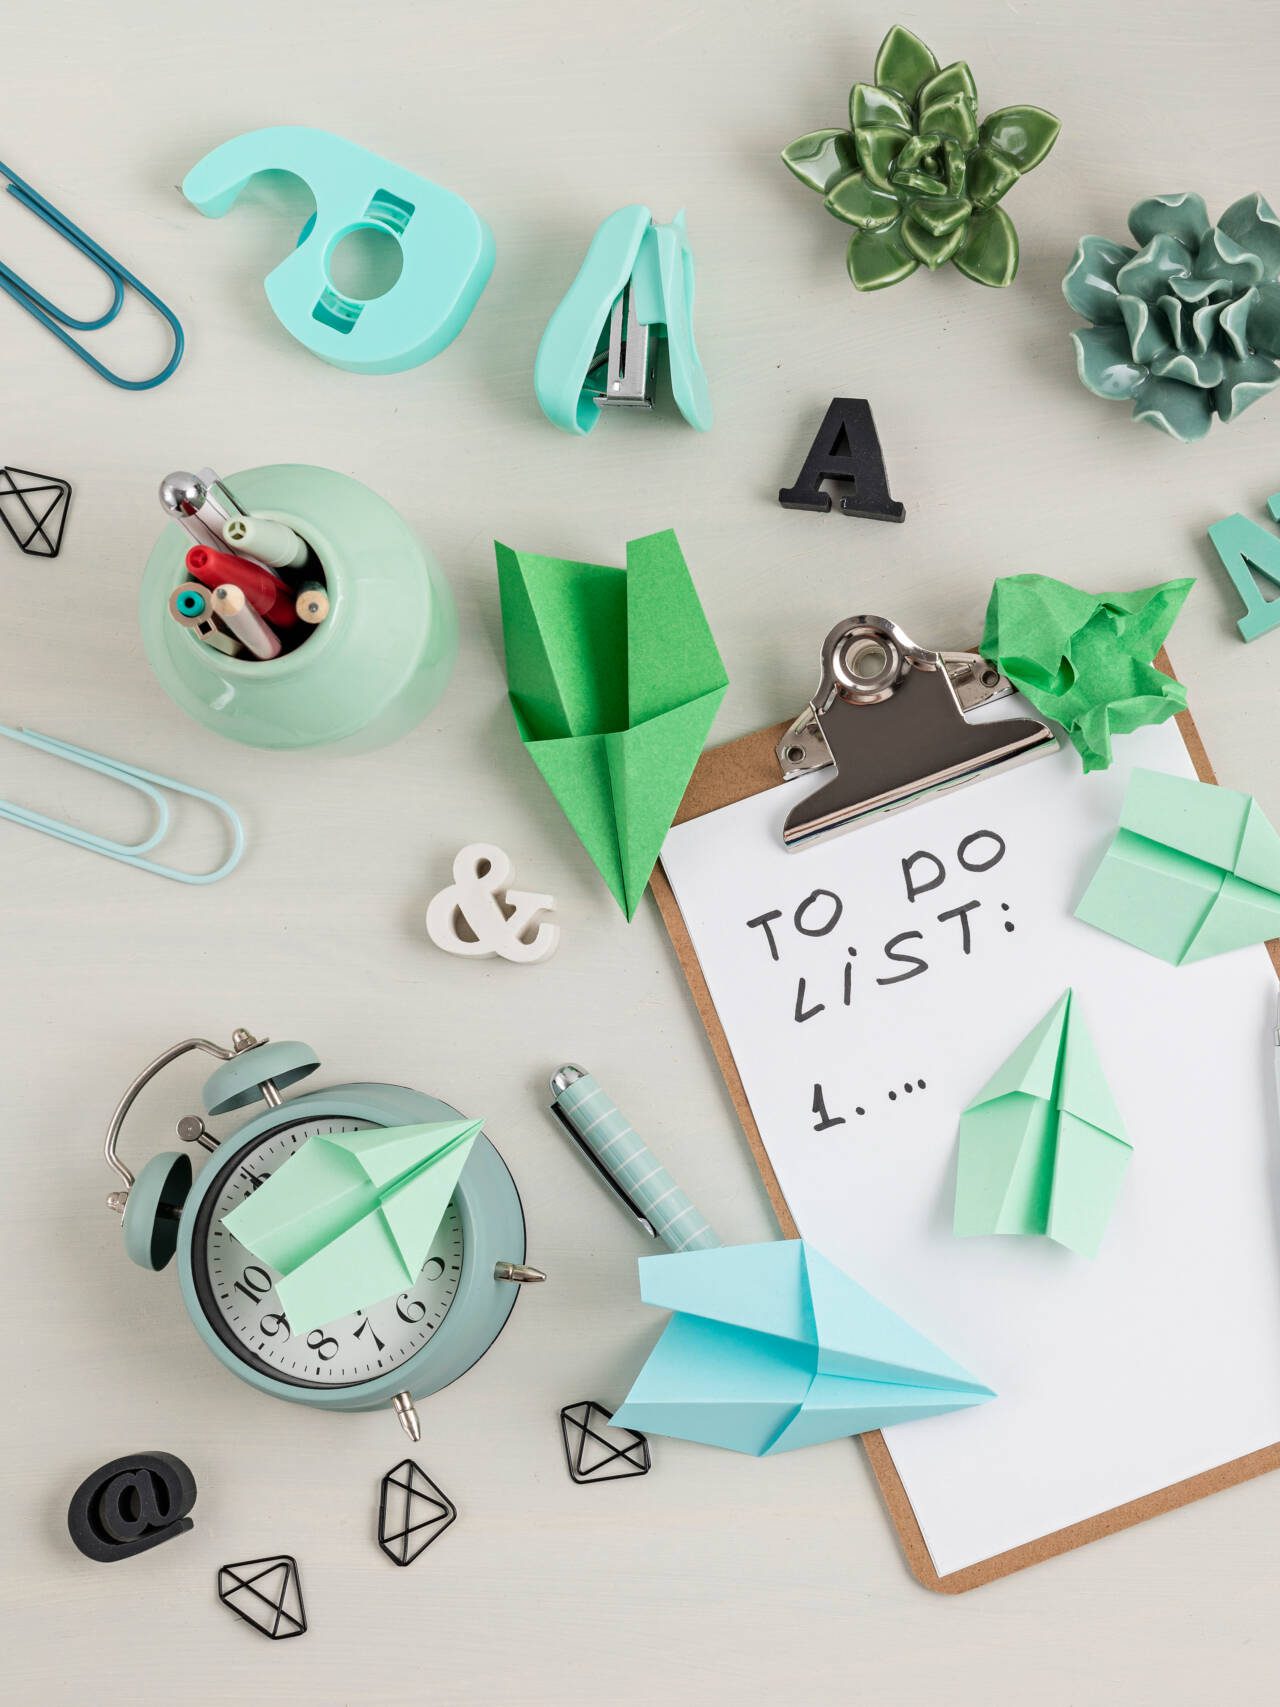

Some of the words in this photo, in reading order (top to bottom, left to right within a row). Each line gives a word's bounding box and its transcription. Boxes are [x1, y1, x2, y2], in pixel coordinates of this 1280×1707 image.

[777, 397, 906, 523] A
[426, 843, 560, 963] &
[746, 889, 843, 961] TO
[901, 829, 1006, 902] DO
[234, 1266, 273, 1305] 10
[260, 1313, 291, 1343] 9
[395, 1293, 426, 1324] 6
[306, 1329, 339, 1361] 8
[353, 1317, 385, 1351] 7
[68, 1450, 197, 1563] @
